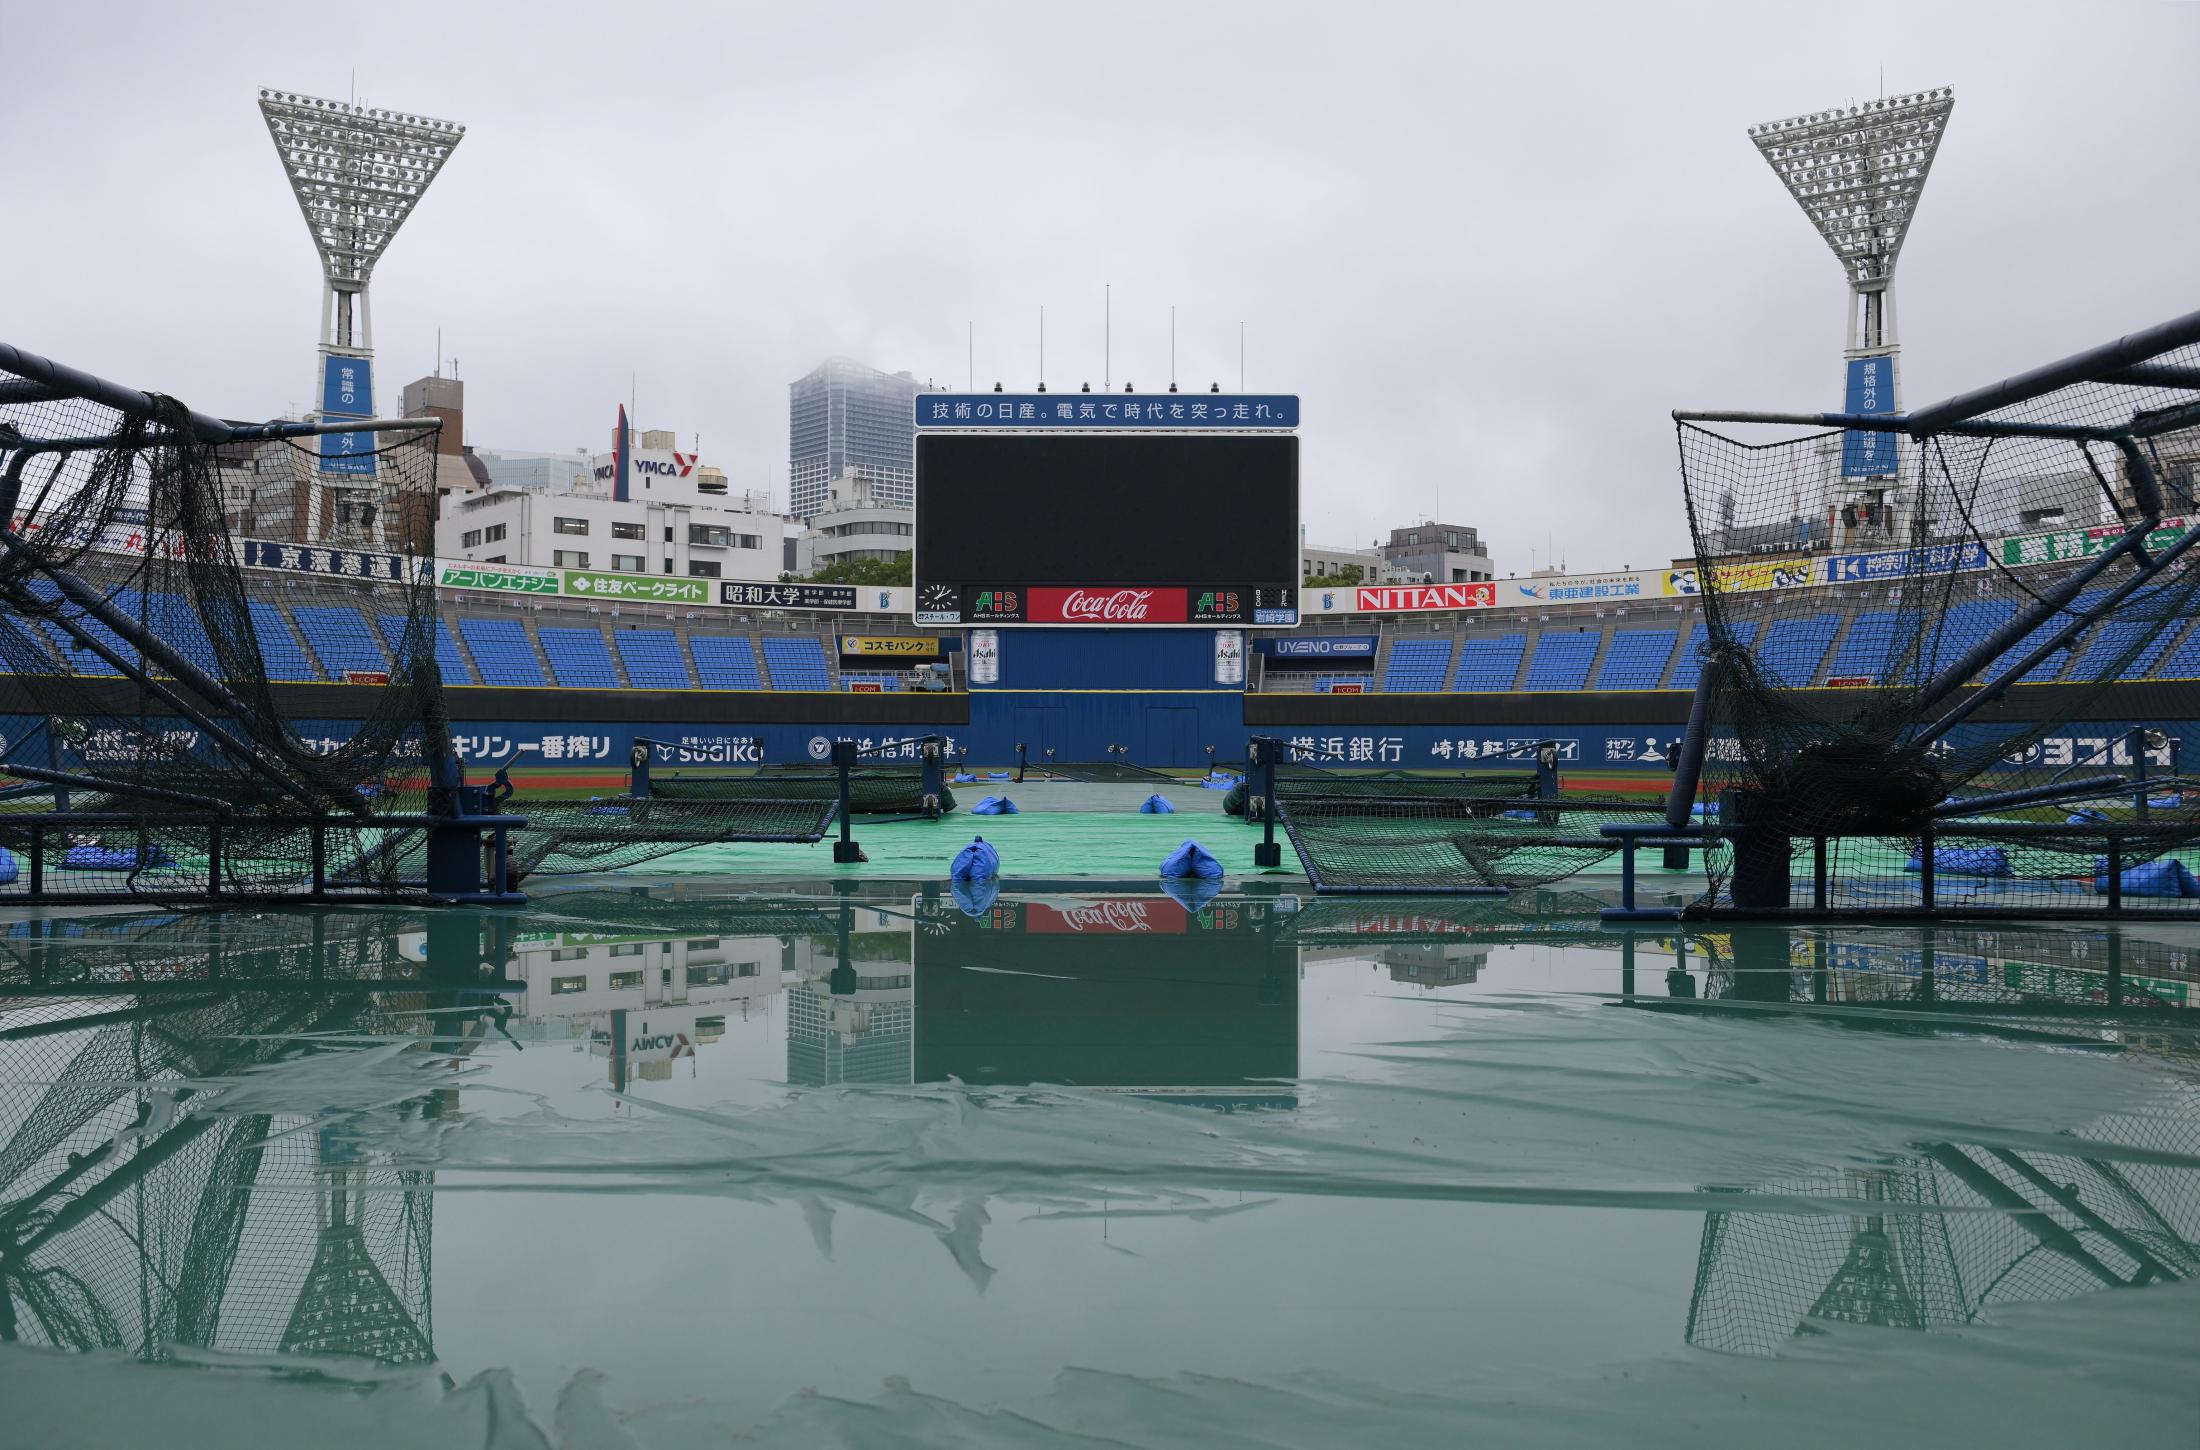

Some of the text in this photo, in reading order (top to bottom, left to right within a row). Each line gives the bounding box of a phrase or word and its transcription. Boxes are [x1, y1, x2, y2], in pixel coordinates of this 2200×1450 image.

[341, 368, 354, 404] 常識の
[1863, 363, 1876, 410] 規格外の
[932, 402, 1286, 421] 技術の日産。電気で時代を突っ走れ。
[635, 459, 677, 477] YMCA
[445, 569, 558, 592] アーバンエナジー
[593, 577, 702, 600] 住友ベークライト
[725, 585, 800, 605] 昭和大学
[1360, 586, 1466, 609] NITTAN
[1548, 584, 1640, 600] 東亜建設工業
[1062, 590, 1152, 619] Coca-Cola
[865, 641, 924, 651] コスモバンク
[973, 648, 996, 659] Asahi
[1217, 648, 1241, 659] Asahi
[1277, 641, 1331, 654] UYENO
[1290, 736, 1404, 762] 横浜銀行
[1606, 739, 1635, 750] オセアン
[1606, 750, 1635, 760] グループ
